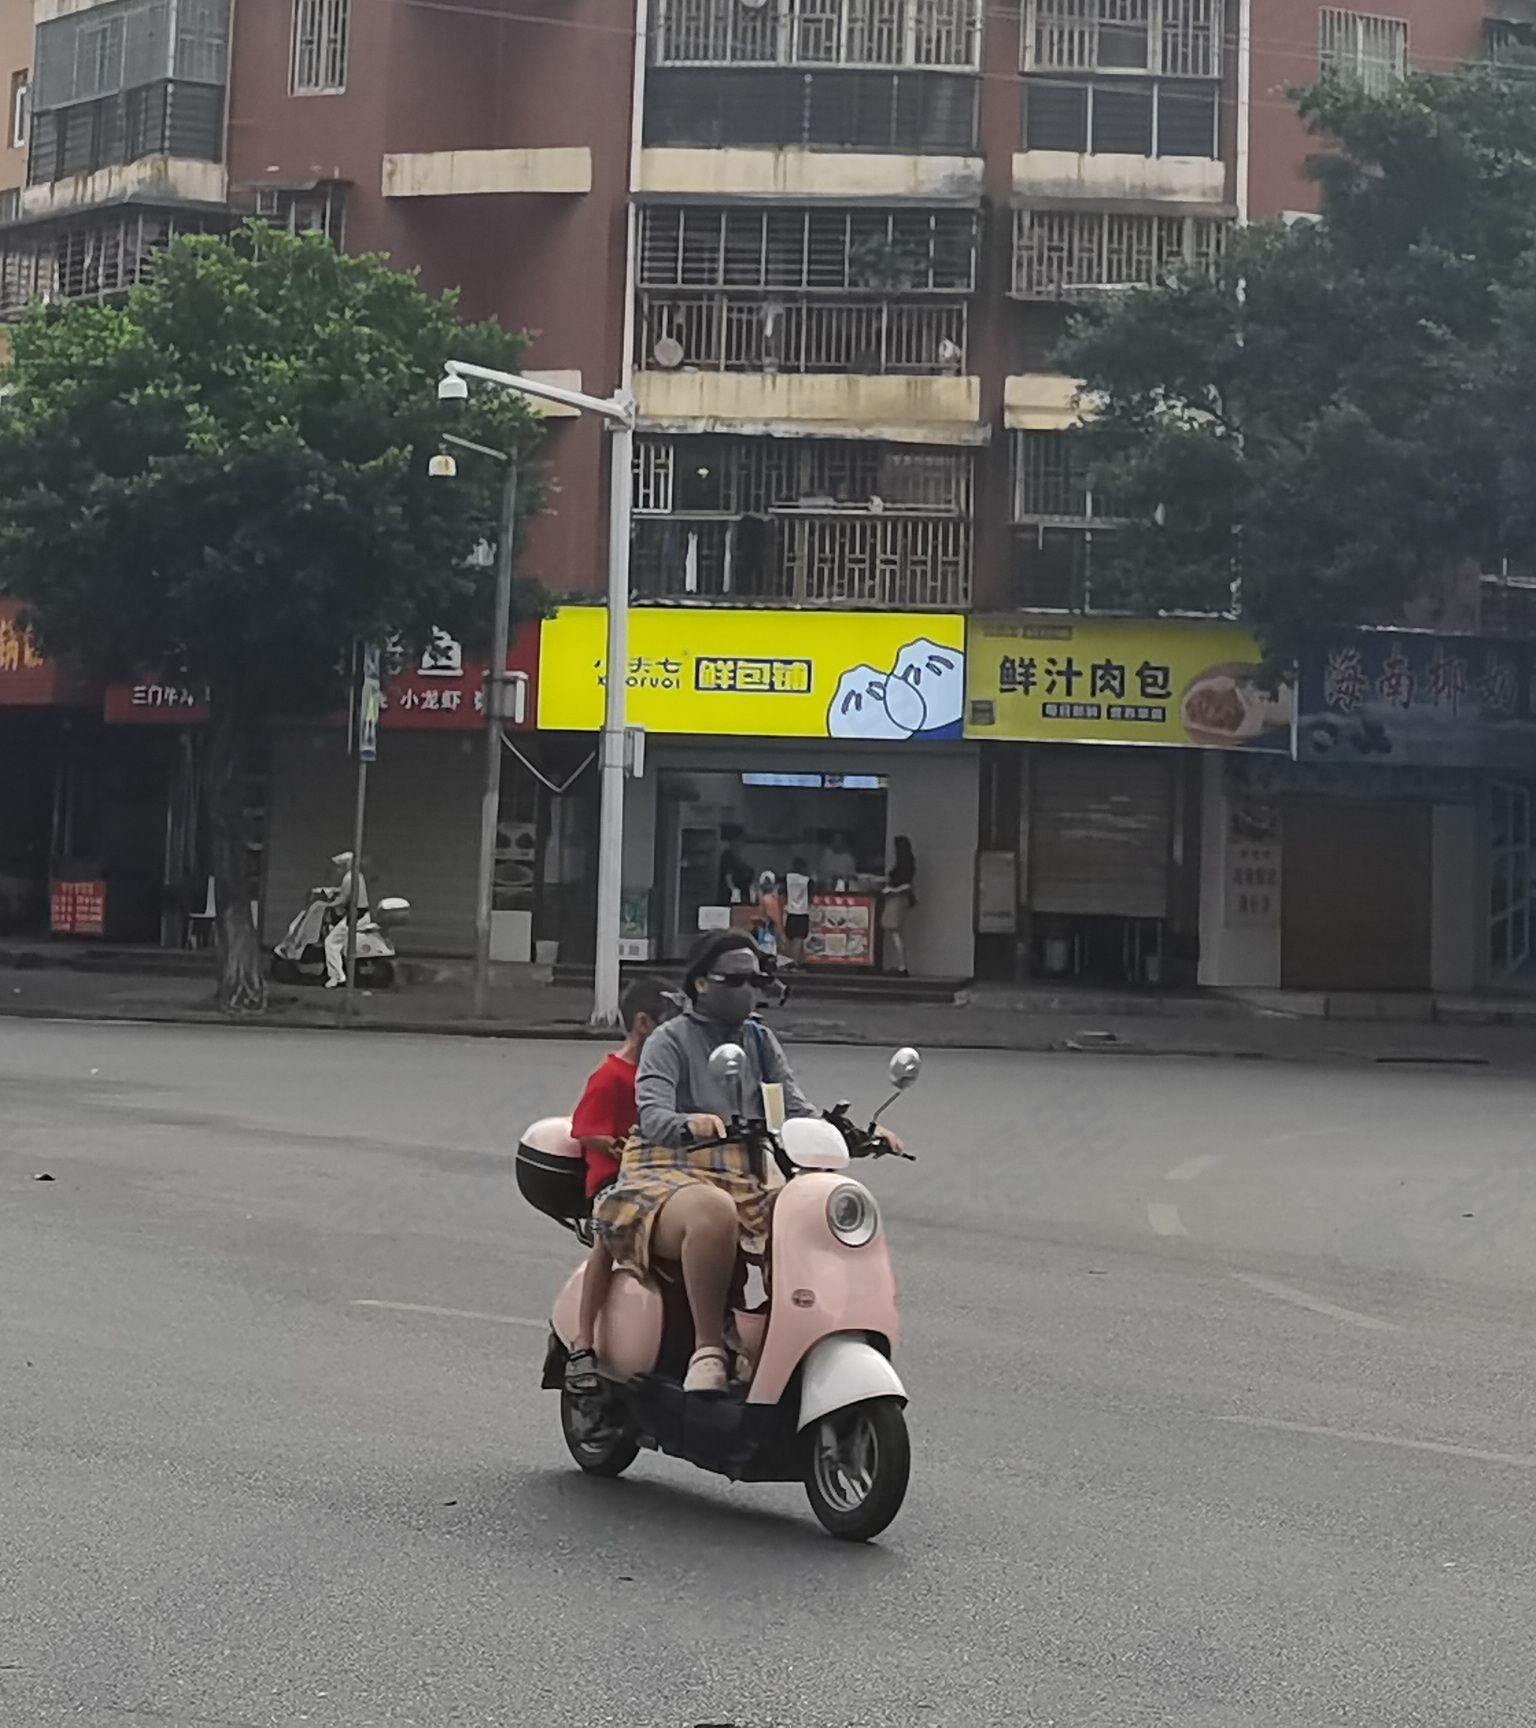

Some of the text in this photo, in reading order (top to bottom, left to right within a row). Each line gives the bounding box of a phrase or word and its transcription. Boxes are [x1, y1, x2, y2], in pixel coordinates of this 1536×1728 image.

[698, 659, 808, 691] 鲜包铺
[999, 655, 1172, 699] 鲜汁肉包
[400, 686, 463, 712] 小龙虾
